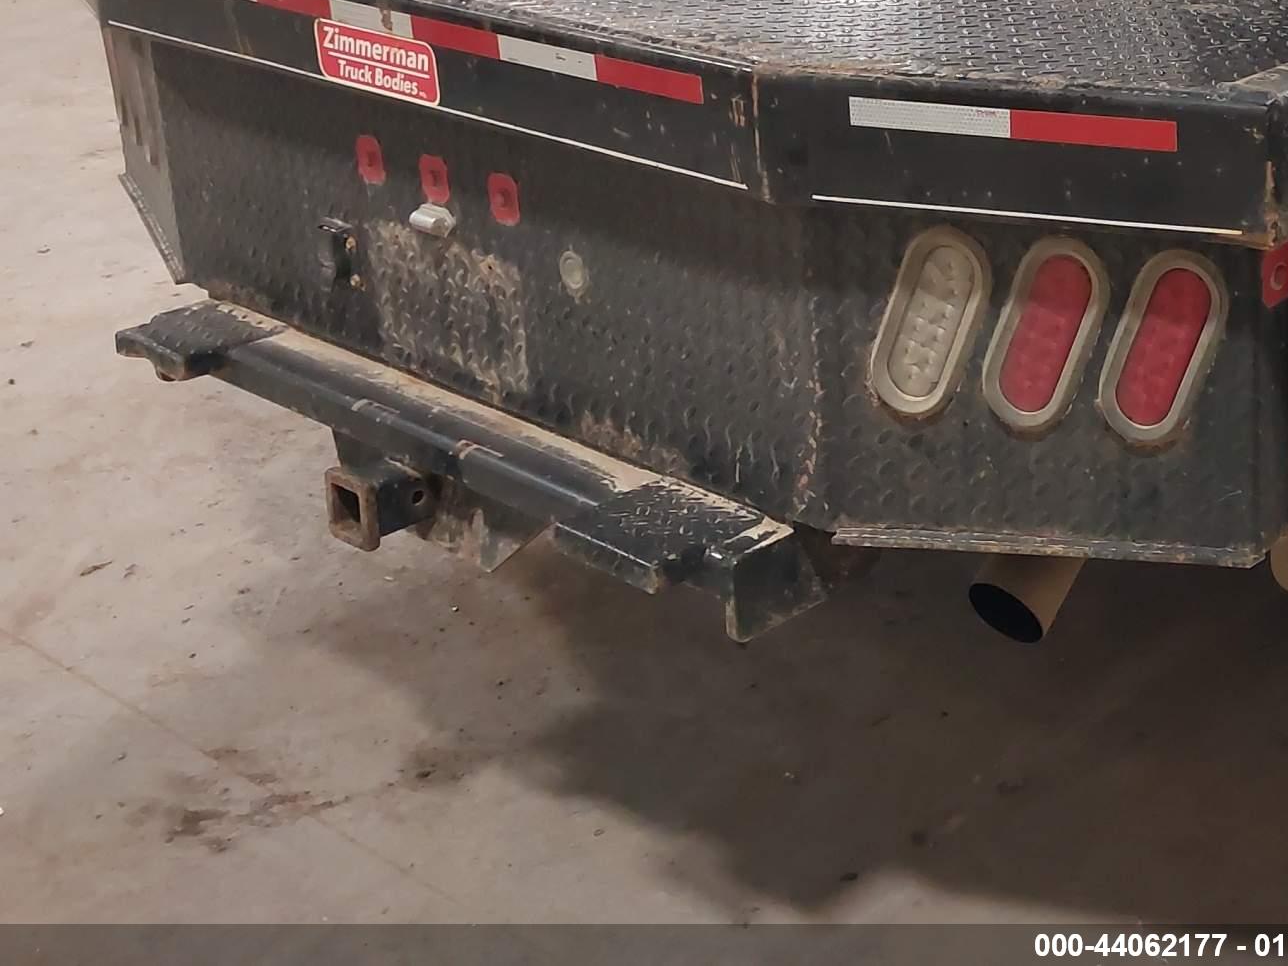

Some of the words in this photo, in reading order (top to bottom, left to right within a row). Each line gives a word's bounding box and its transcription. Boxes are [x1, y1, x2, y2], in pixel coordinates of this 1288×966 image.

[323, 25, 428, 72] Zimmerman
[338, 60, 372, 84] Truck
[374, 67, 418, 95] Bodies
